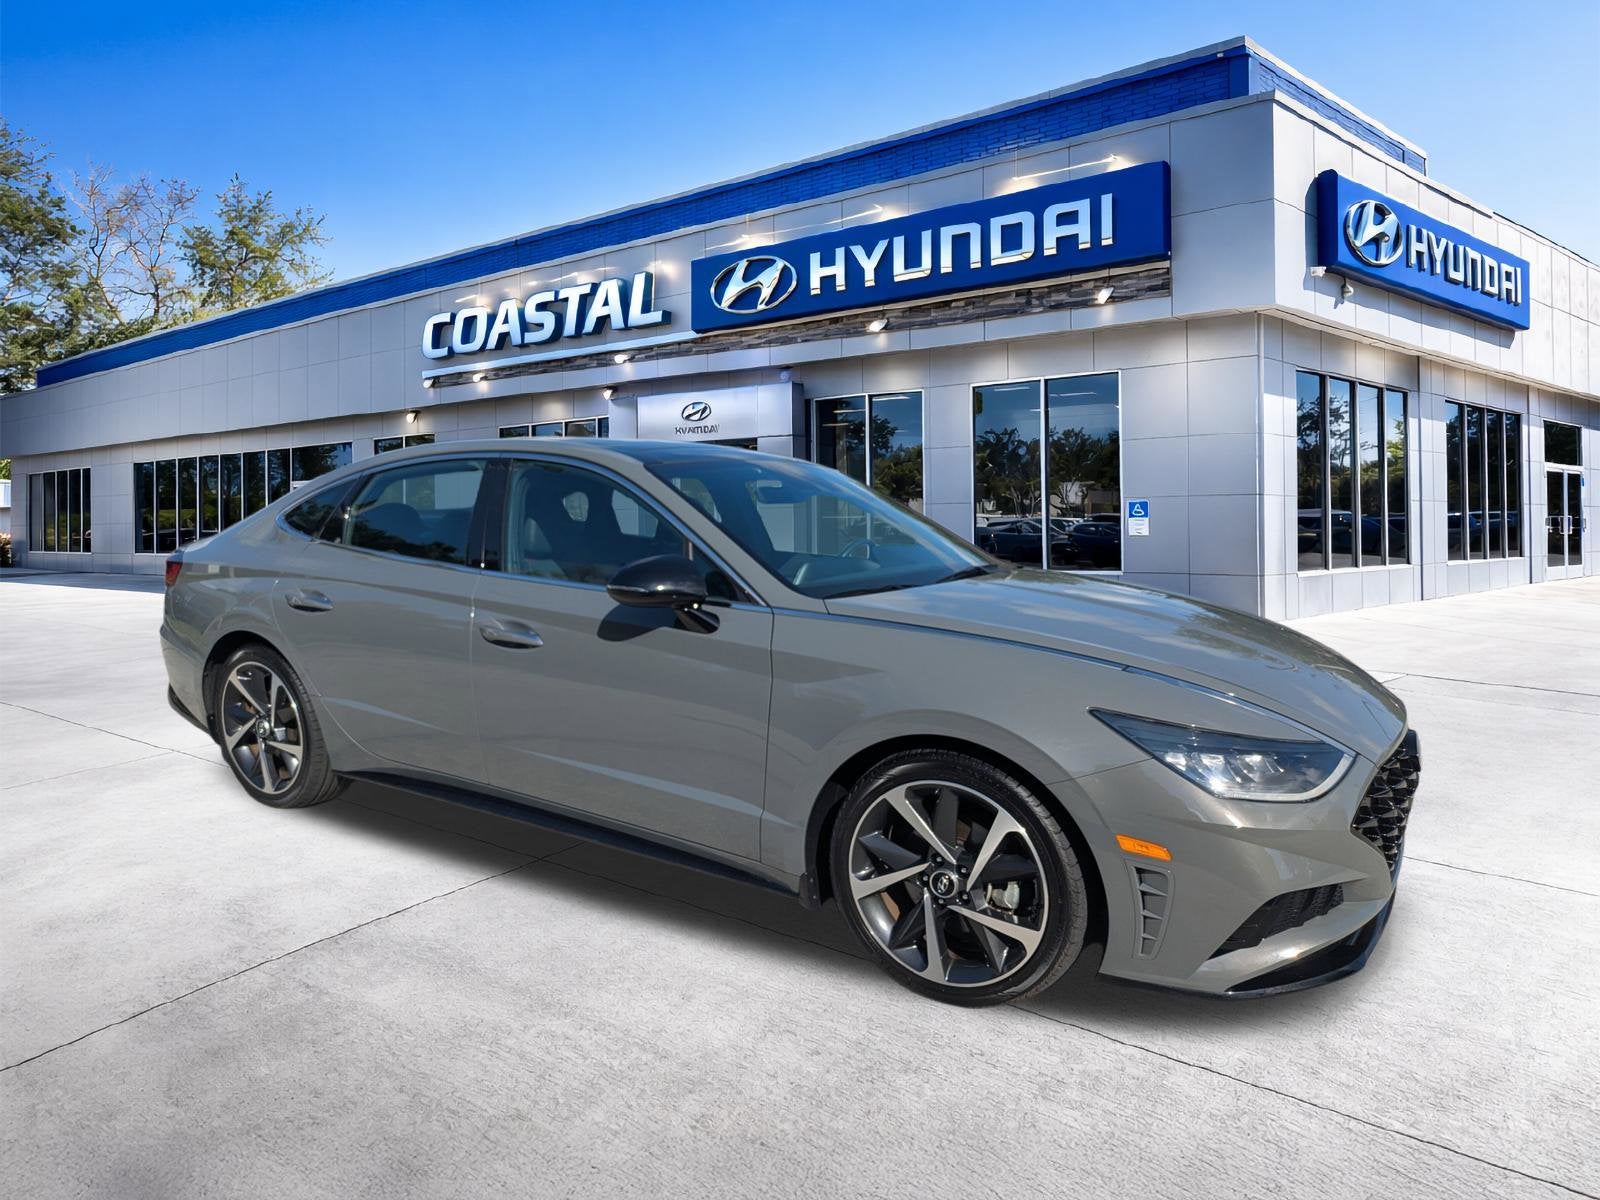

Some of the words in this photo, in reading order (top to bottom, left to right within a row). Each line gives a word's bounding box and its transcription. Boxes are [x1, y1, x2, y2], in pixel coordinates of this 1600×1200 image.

[809, 192, 1114, 296] HYUNDAI
[1406, 224, 1522, 306] HYUNDAI
[421, 271, 672, 360] COASTAL
